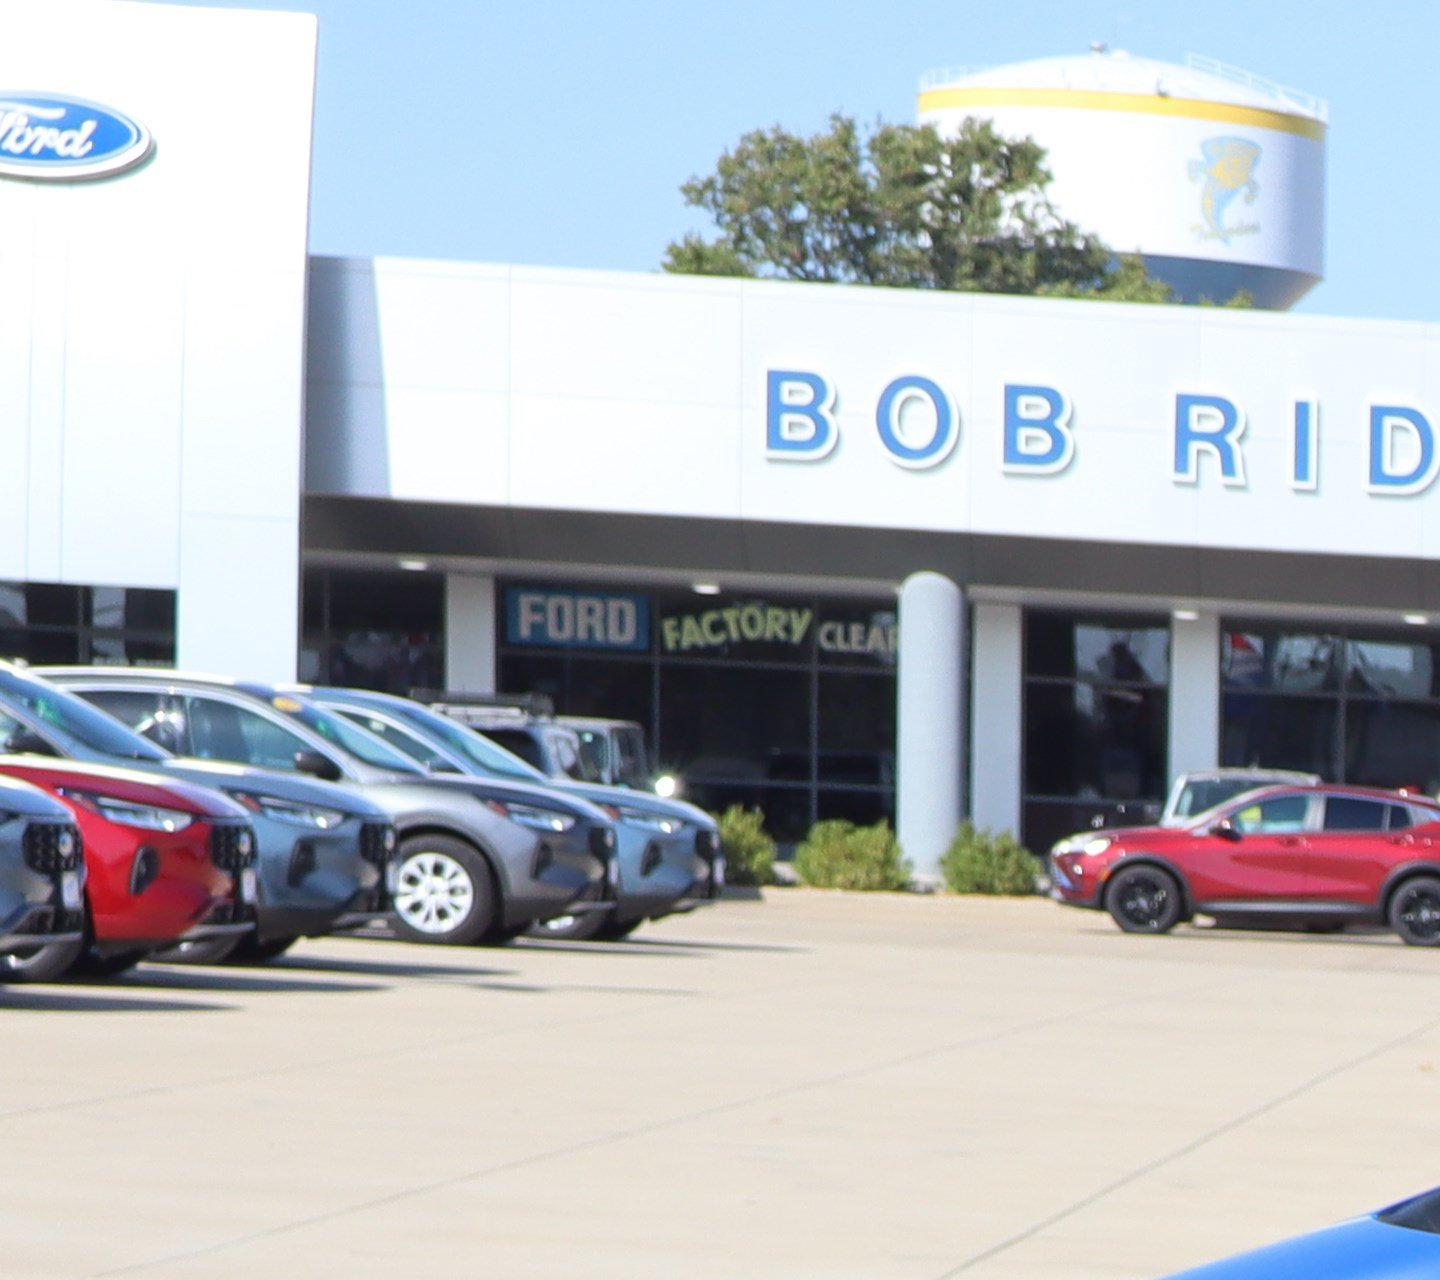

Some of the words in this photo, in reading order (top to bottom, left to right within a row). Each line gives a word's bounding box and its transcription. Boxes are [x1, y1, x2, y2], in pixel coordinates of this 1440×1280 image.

[766, 367, 1073, 474] BOB
[517, 594, 636, 646] FORD
[660, 606, 812, 652] FACTORY
